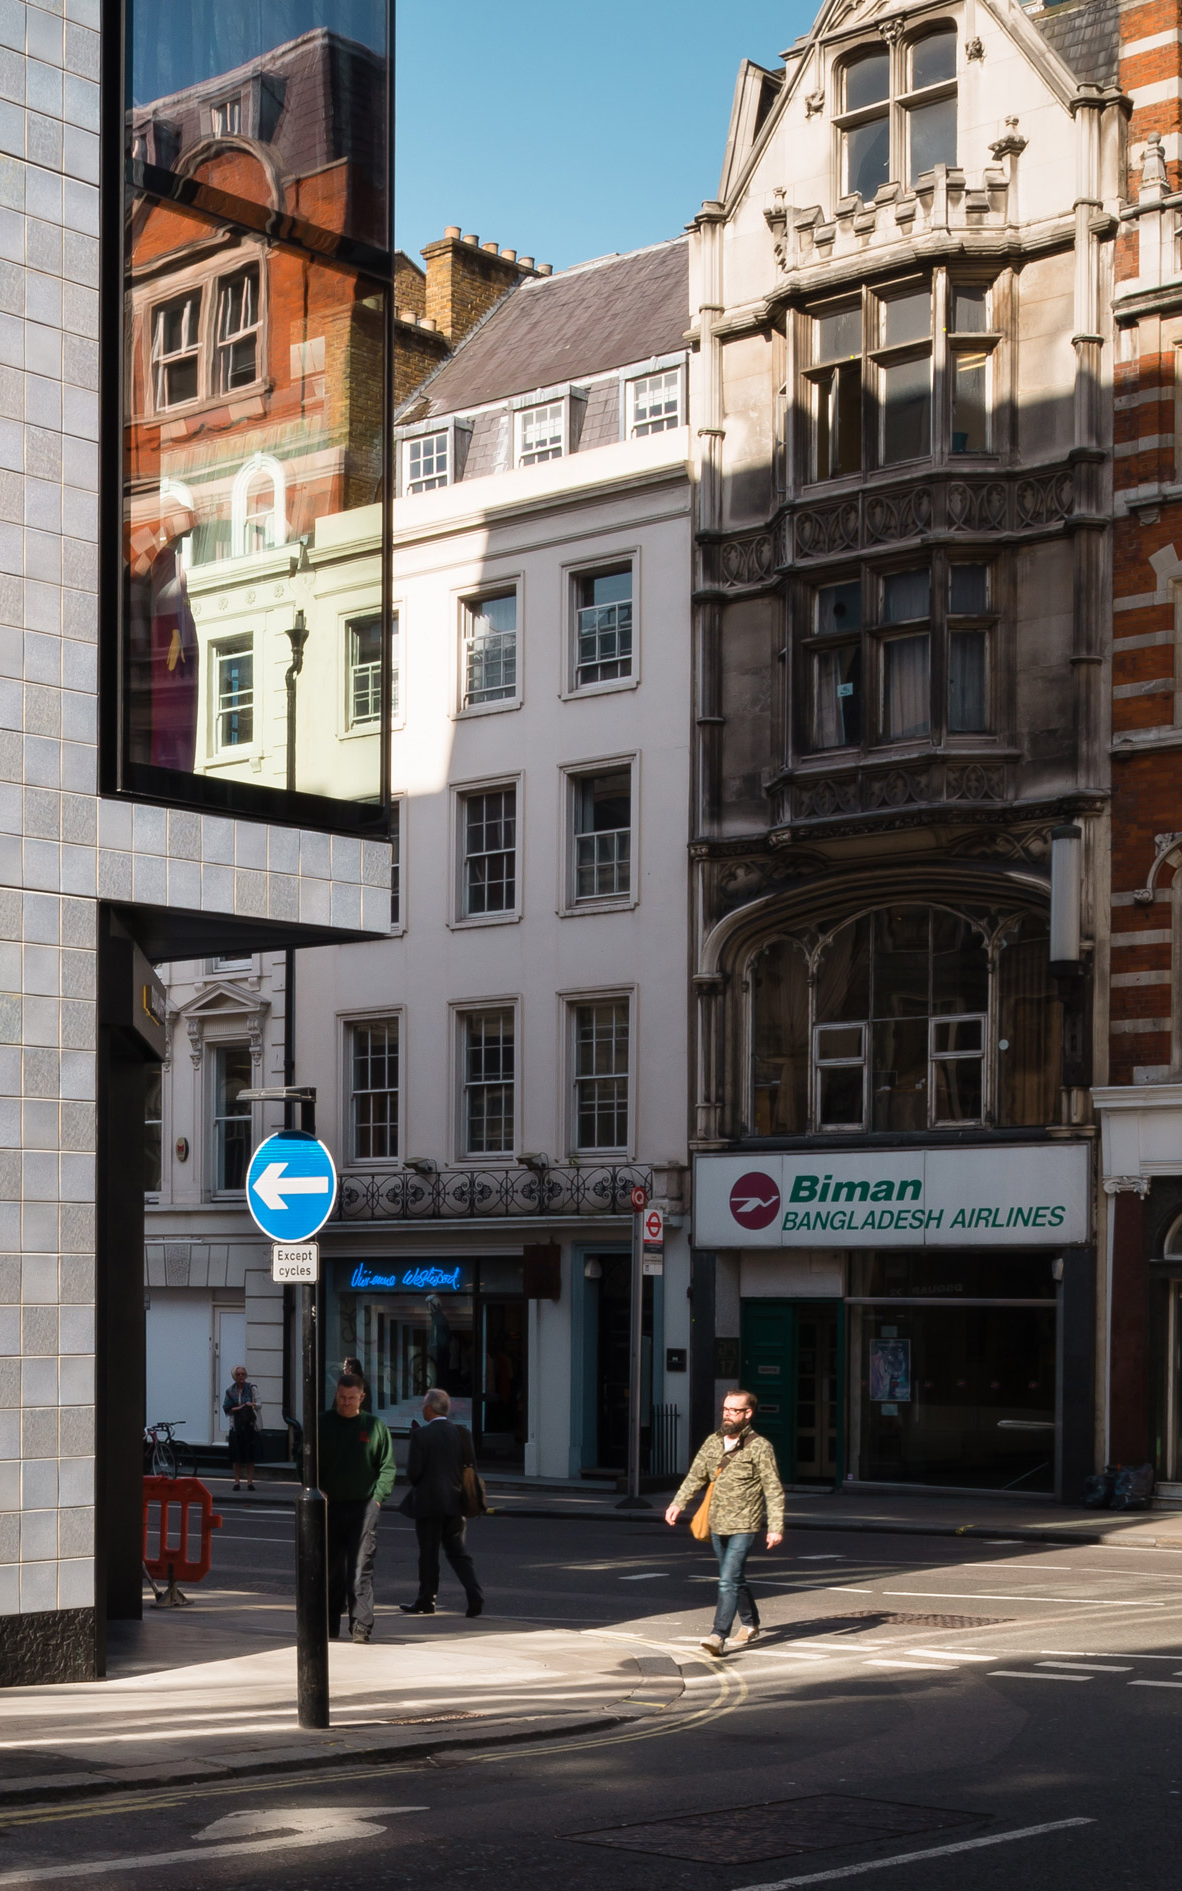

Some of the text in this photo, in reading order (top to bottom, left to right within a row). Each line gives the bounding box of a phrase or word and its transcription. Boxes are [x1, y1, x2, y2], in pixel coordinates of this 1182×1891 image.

[788, 1174, 923, 1203] Biman
[634, 1190, 645, 1205] Q
[781, 1205, 1067, 1231] BANGLADESH AIRLINES
[277, 1249, 313, 1263] Except
[278, 1264, 312, 1278] cycles
